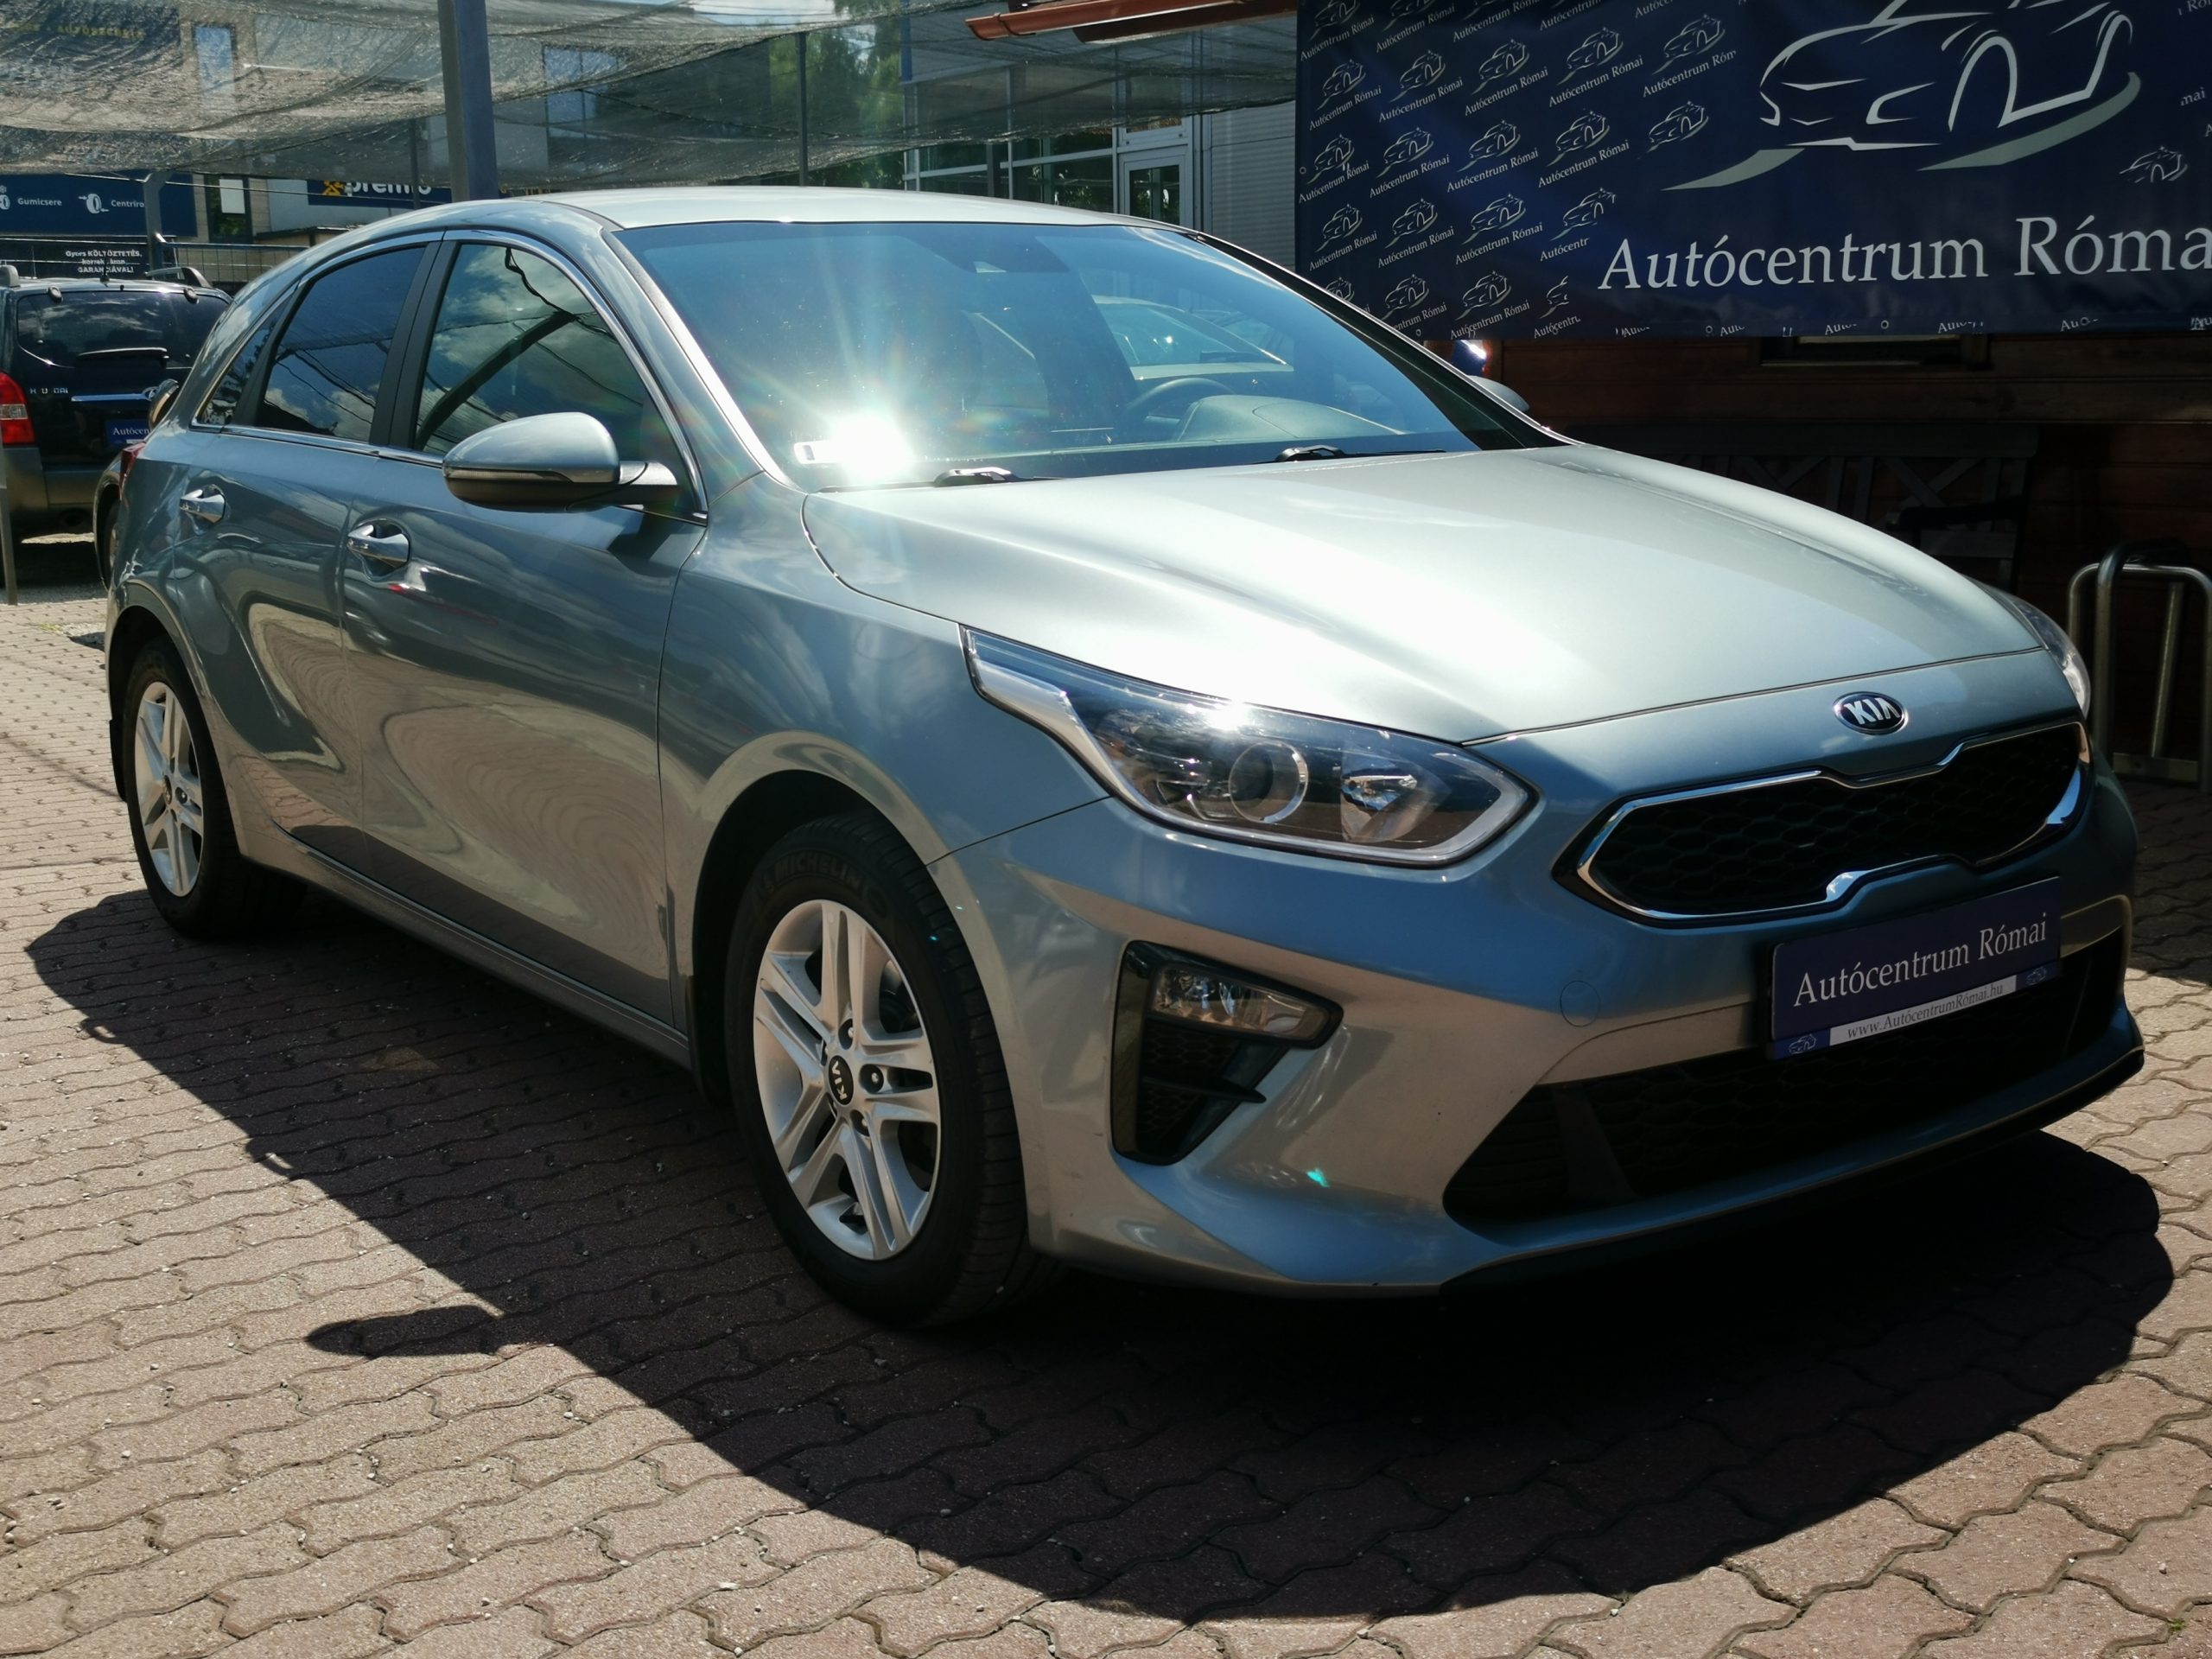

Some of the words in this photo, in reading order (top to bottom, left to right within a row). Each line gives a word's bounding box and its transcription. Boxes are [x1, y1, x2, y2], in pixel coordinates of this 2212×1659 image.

[1300, 29, 1351, 61] Autócentrum
[1351, 15, 1376, 34] Római
[1379, 92, 1437, 123] Autócentrum
[1438, 76, 1464, 98] Római
[1465, 84, 1519, 116] Autócentrum
[1520, 66, 1548, 87] Római
[1548, 73, 1610, 107] Autócentrum
[1611, 54, 1643, 79] Római
[1643, 61, 1710, 97] Autócentrum
[1309, 101, 1353, 131] Autócentrum
[1354, 84, 1382, 105] Római
[1370, 170, 1420, 199] Autócentrum
[1421, 154, 1450, 174] Római
[1447, 164, 1509, 193] Autócentrum
[1510, 147, 1539, 168] Római
[1538, 156, 1598, 188] Autócentrum
[1599, 139, 1630, 161] Római
[17, 197, 62, 207] Gumicsere
[1299, 175, 1345, 204] Autócentrum
[1309, 244, 1353, 271] Autócentrum
[1354, 231, 1377, 249] Római
[1378, 240, 1427, 268] Autócentrum
[1429, 226, 1455, 245] Római
[1455, 235, 1510, 265] Autócentrum
[1512, 222, 1543, 241] Római
[1597, 232, 1990, 290] Autócentrum
[2013, 214, 2212, 276] Róma
[1421, 302, 1447, 320] Római
[1504, 299, 1530, 319] Római
[1793, 943, 1969, 1007] Autócentrum
[1979, 912, 2047, 962] Római
